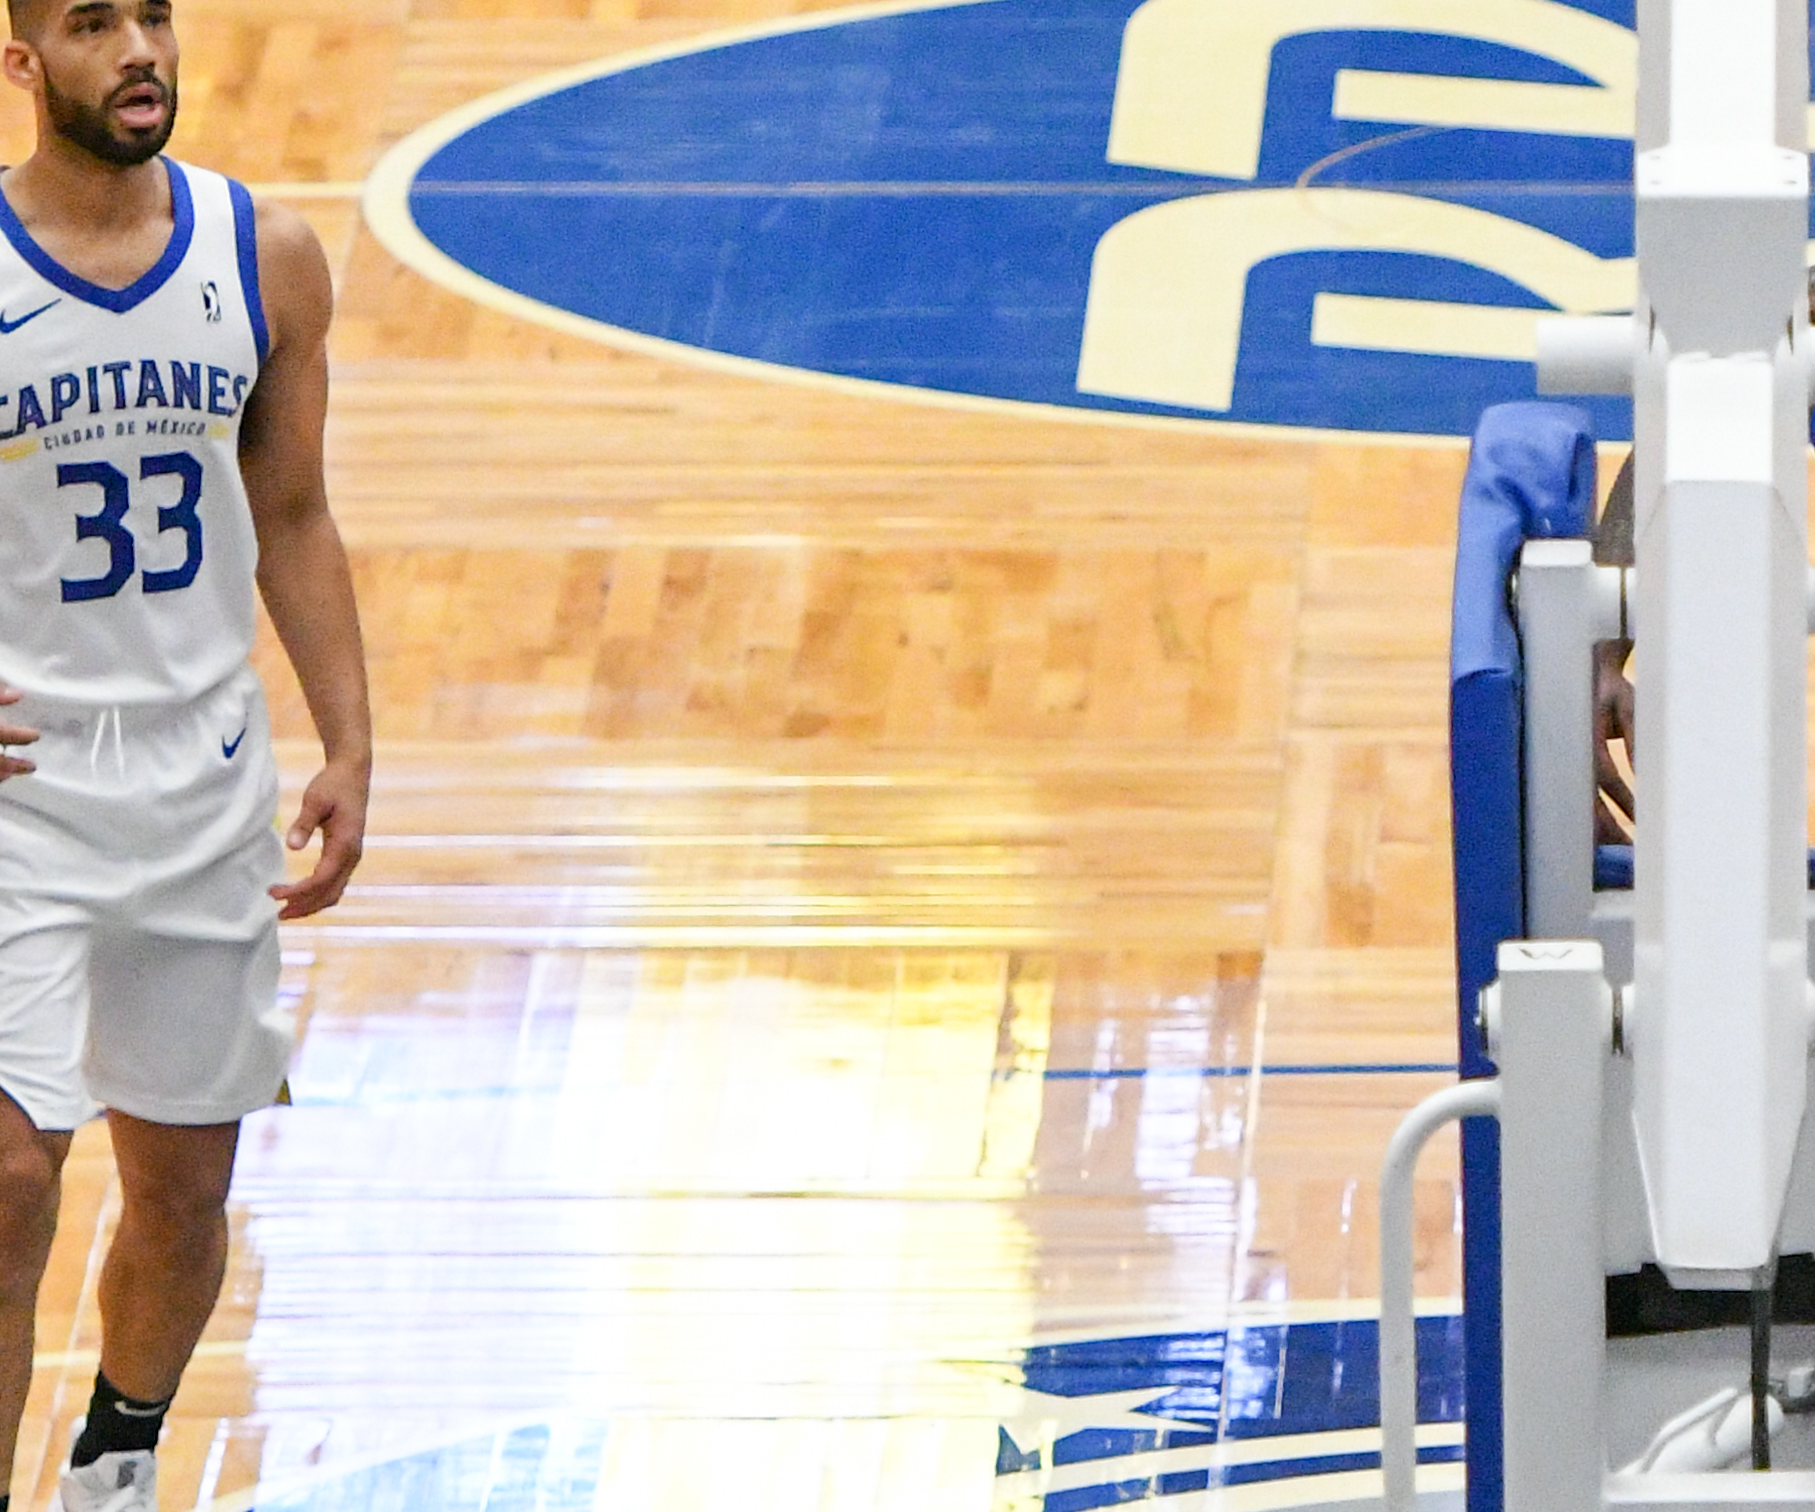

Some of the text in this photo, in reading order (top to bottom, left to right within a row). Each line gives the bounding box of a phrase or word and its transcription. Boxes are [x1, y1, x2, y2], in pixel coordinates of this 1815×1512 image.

[44, 424, 105, 450] CIUDAD
[116, 421, 135, 436] DE
[57, 451, 203, 604] 33
